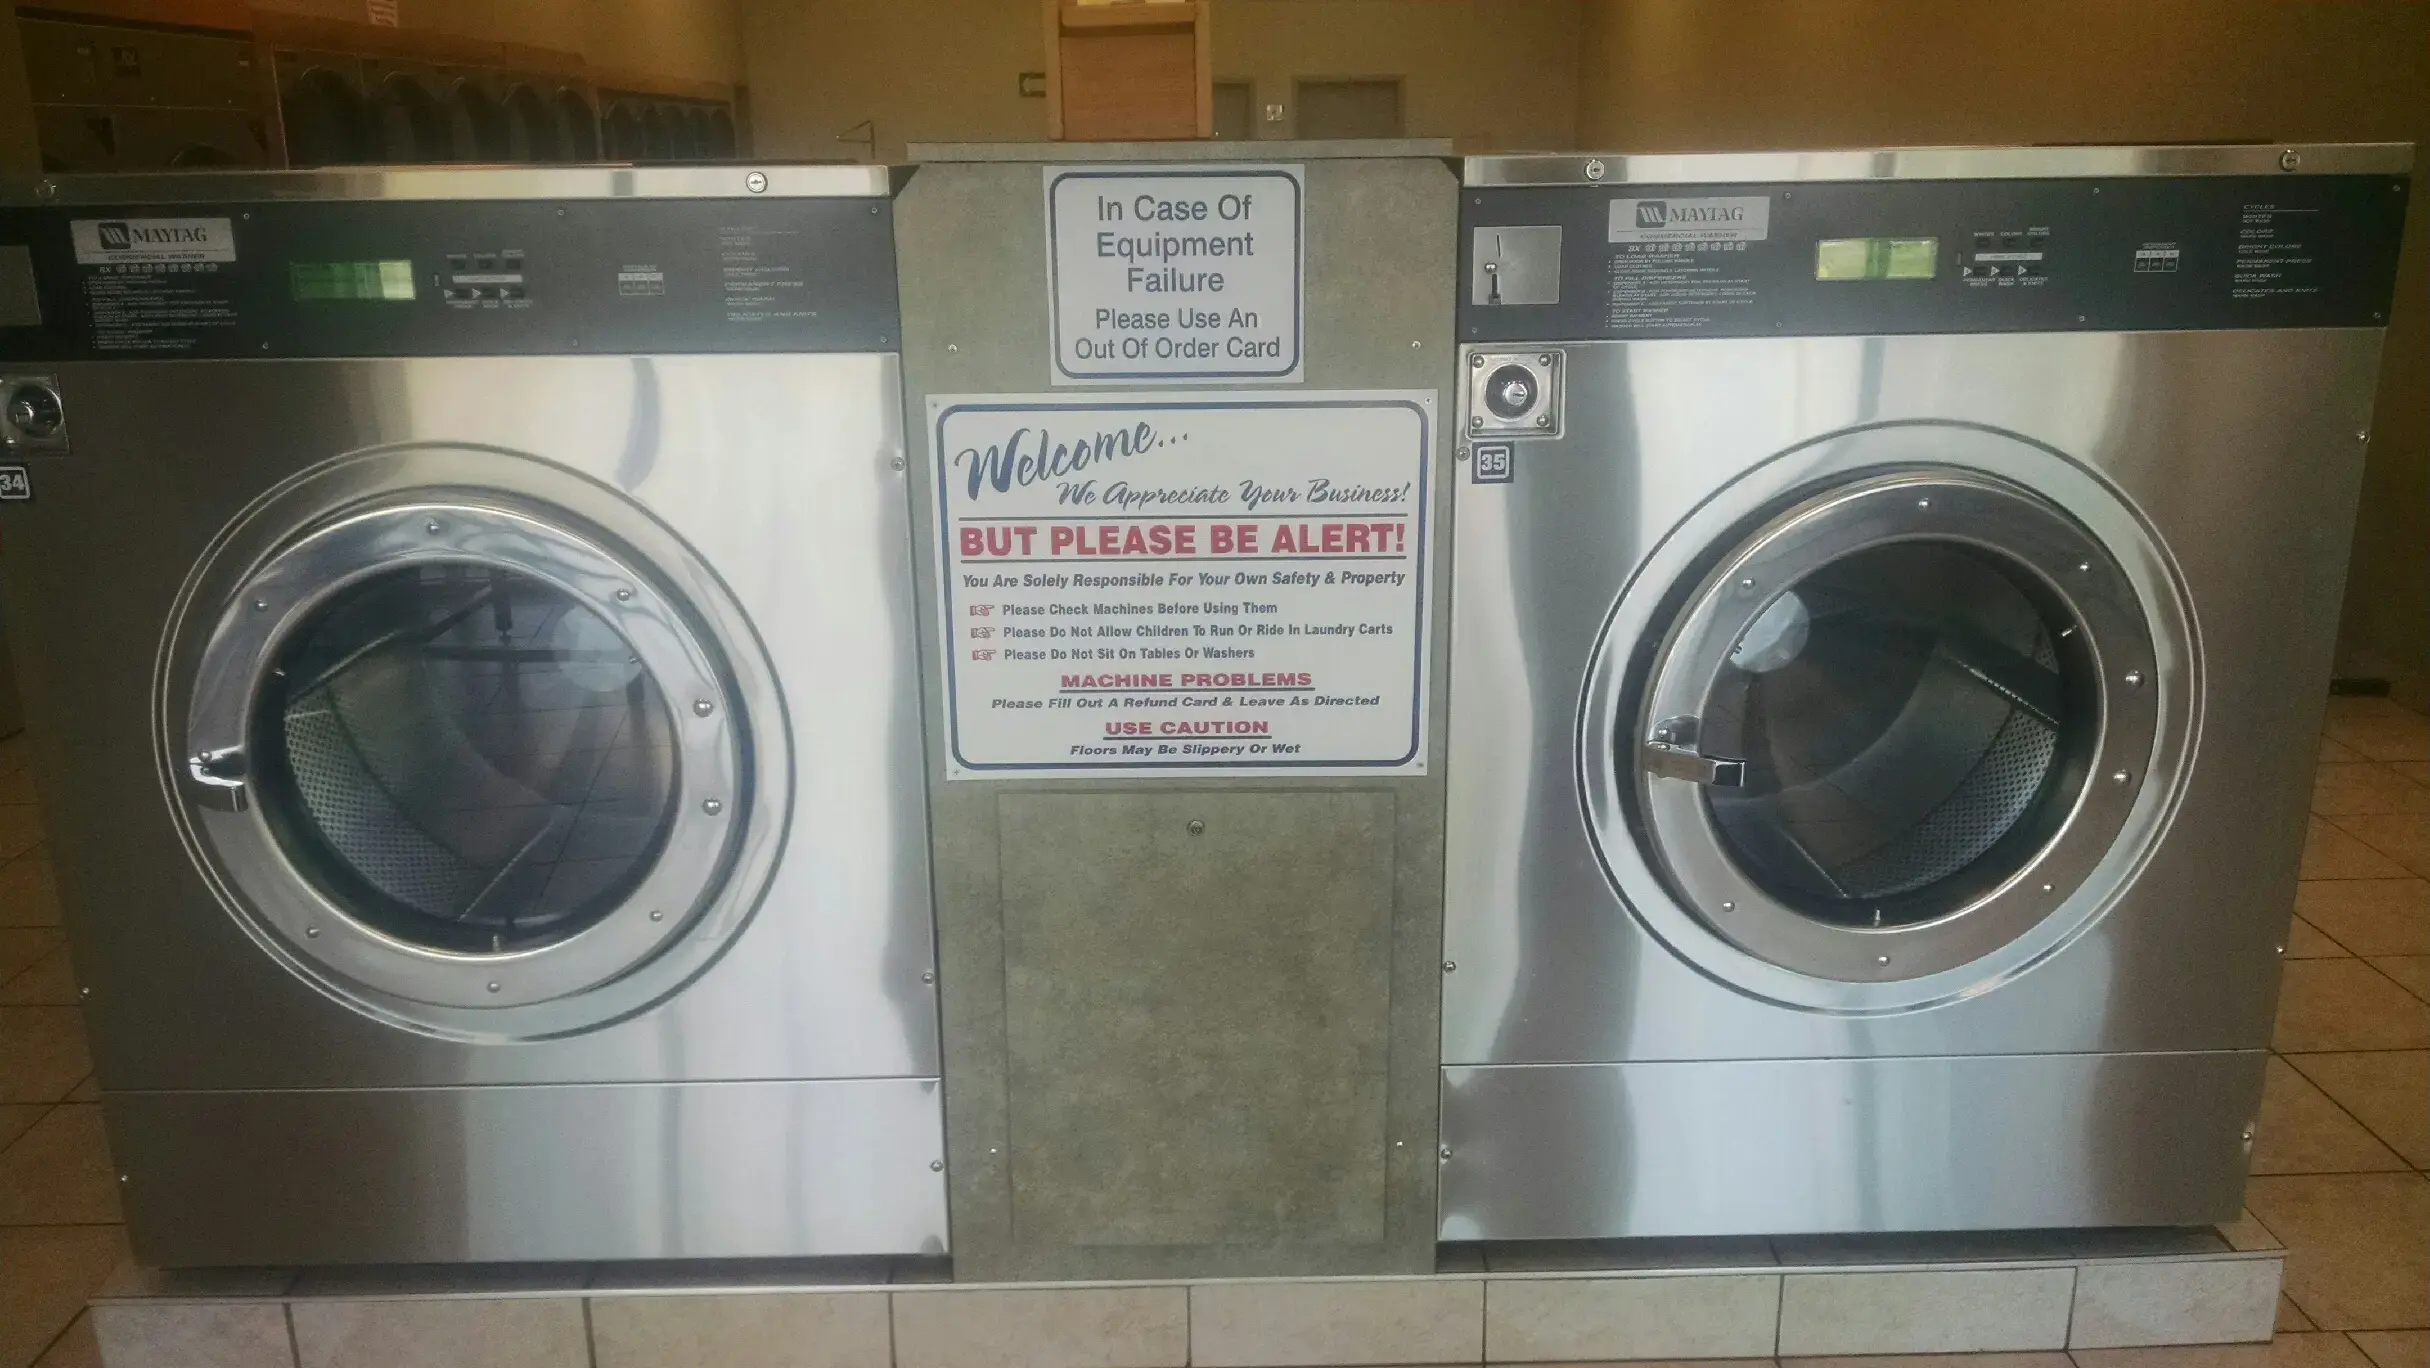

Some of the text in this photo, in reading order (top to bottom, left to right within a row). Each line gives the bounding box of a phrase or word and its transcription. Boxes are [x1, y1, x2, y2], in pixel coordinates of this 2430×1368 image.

[1099, 194, 1252, 221] In Case Of
[1670, 206, 1744, 223] MAYTAG
[131, 227, 208, 243] MAYTAG
[1097, 232, 1254, 263] Equipment
[1128, 268, 1224, 292] Failure
[1096, 308, 1257, 329] Please Use An
[1076, 337, 1280, 359] Out Of Order Card
[1481, 453, 1506, 471] 35
[0, 474, 24, 490] 34
[1056, 479, 1411, 511] We Appreciate Your Business!
[960, 523, 1404, 556] BUT PLEASE BE ALERT!
[963, 571, 1405, 589] You Are Solely Responsible For Your Own Safety & Property
[1003, 602, 1277, 615] Please Check Machines Before Using Them
[1004, 623, 1393, 637] Please Do Not Allow Children To Run Or Ride In Laundry Carts
[1005, 647, 1254, 660] Please Do Not Sit On Tables Or Washers
[1062, 673, 1311, 687] MACHINE PROBLEMS
[992, 696, 1380, 708] Please Fill Out A Refund Card & Leave As Directed
[1106, 721, 1268, 735] USE CAUTION
[1070, 744, 1301, 756] Floors May Be Slippery Or Wet
